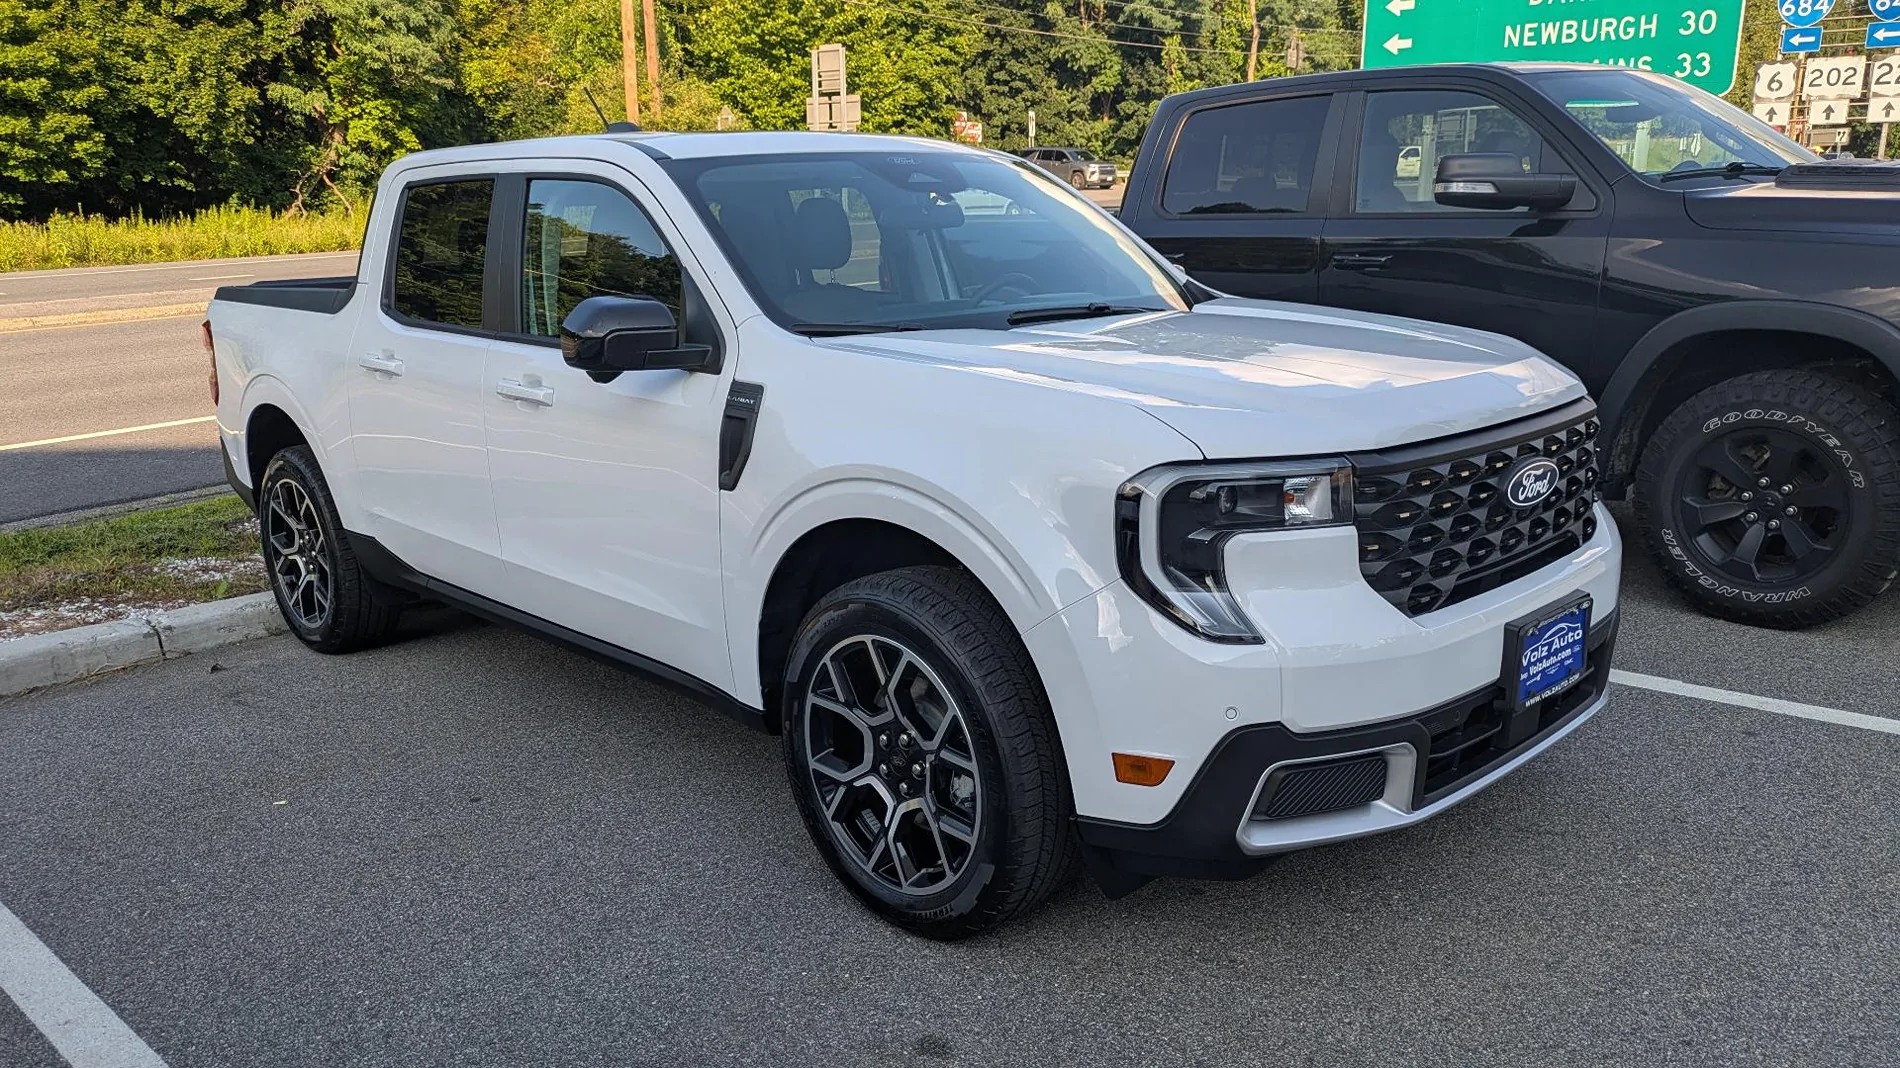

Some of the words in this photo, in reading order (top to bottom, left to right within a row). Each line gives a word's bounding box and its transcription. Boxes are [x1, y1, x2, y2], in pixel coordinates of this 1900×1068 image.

[1503, 13, 1658, 48] NEWBURGH
[1678, 9, 1718, 36] 30
[1674, 52, 1711, 78] 33
[1766, 70, 1783, 92] 6
[1808, 66, 1858, 87] 202
[1702, 408, 1865, 489] GOODYEAR
[1518, 468, 1551, 501] Ford
[1661, 528, 1811, 604] WRANGLER
[1522, 645, 1549, 667] Volz
[1551, 629, 1583, 653] Auto
[1529, 648, 1572, 676] VolzAuto.com
